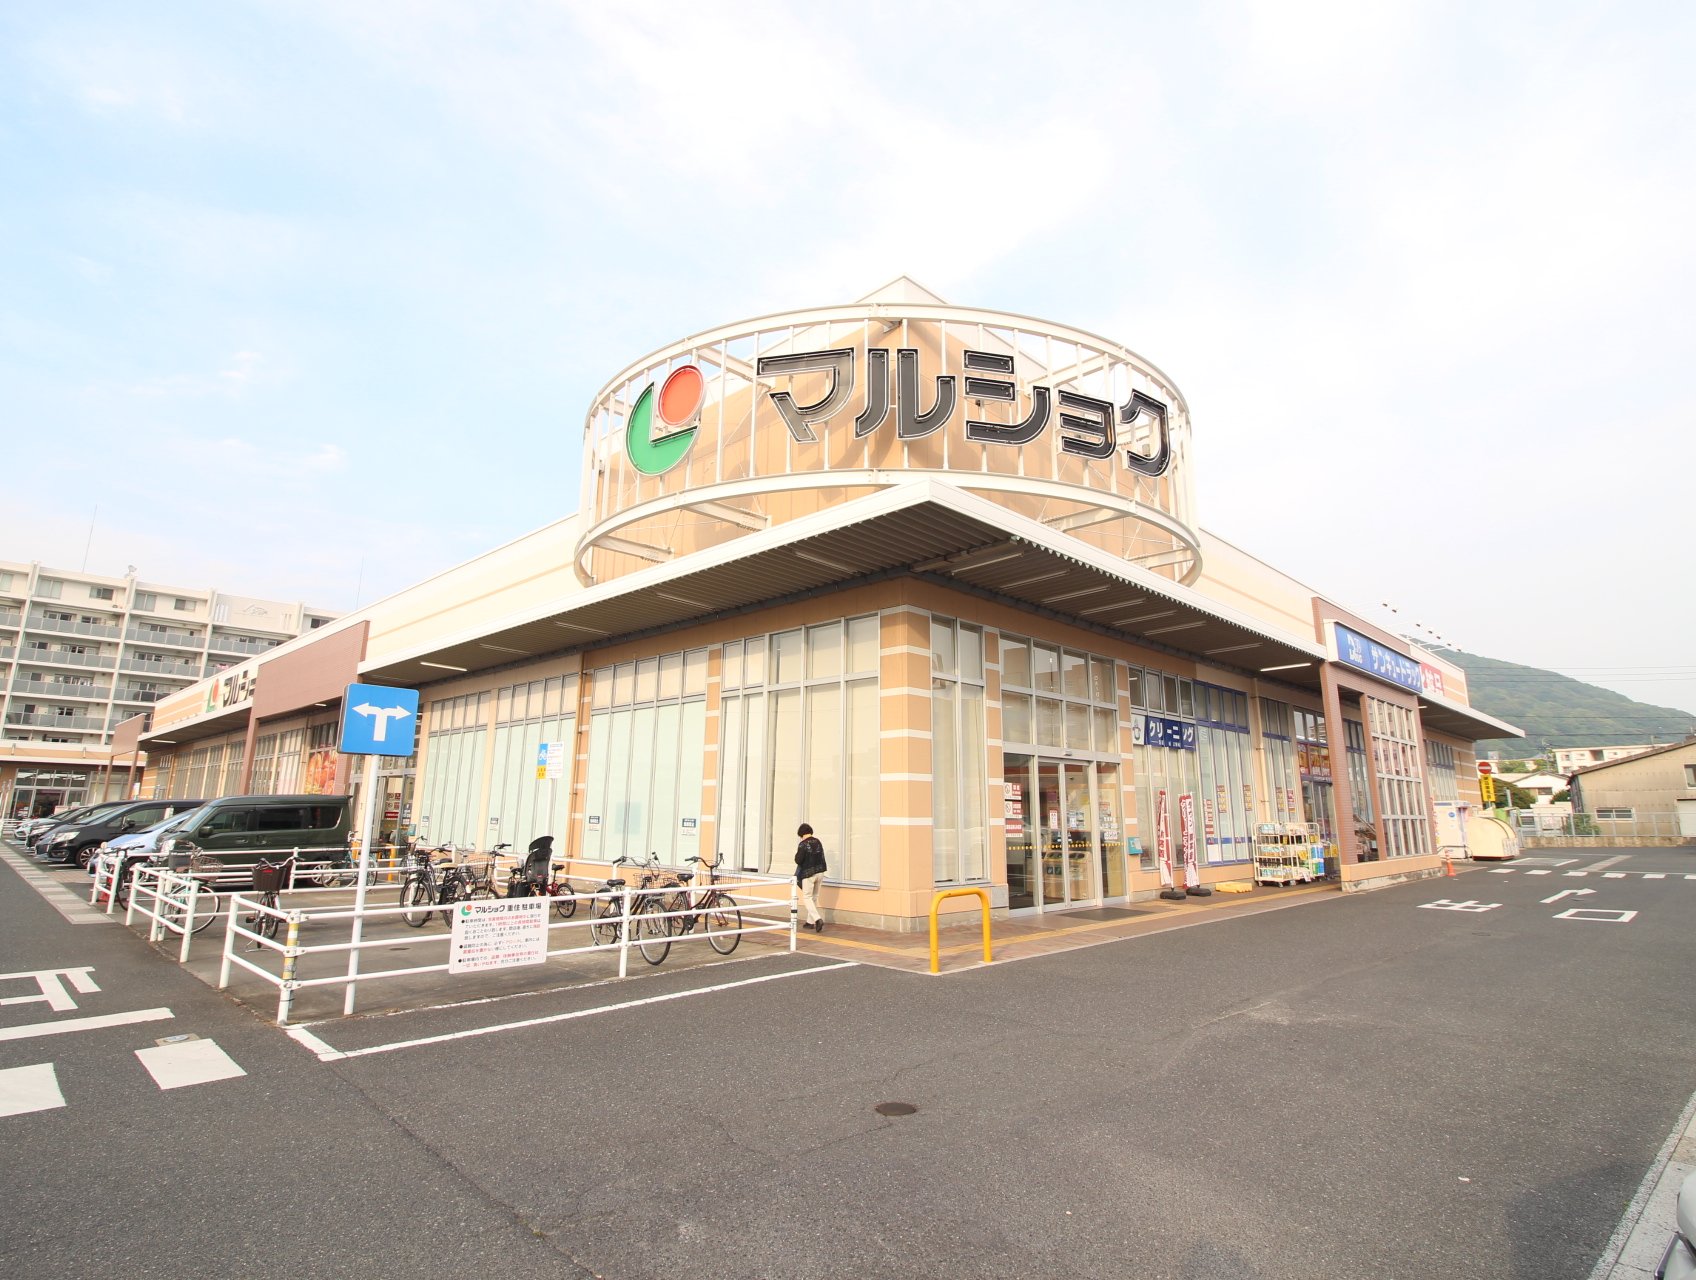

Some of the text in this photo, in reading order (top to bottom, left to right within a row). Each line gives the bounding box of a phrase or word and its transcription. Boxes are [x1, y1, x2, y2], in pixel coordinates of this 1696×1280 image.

[757, 346, 1171, 478] マルショク
[1149, 720, 1194, 743] クリーニング
[475, 904, 506, 914] マルショク
